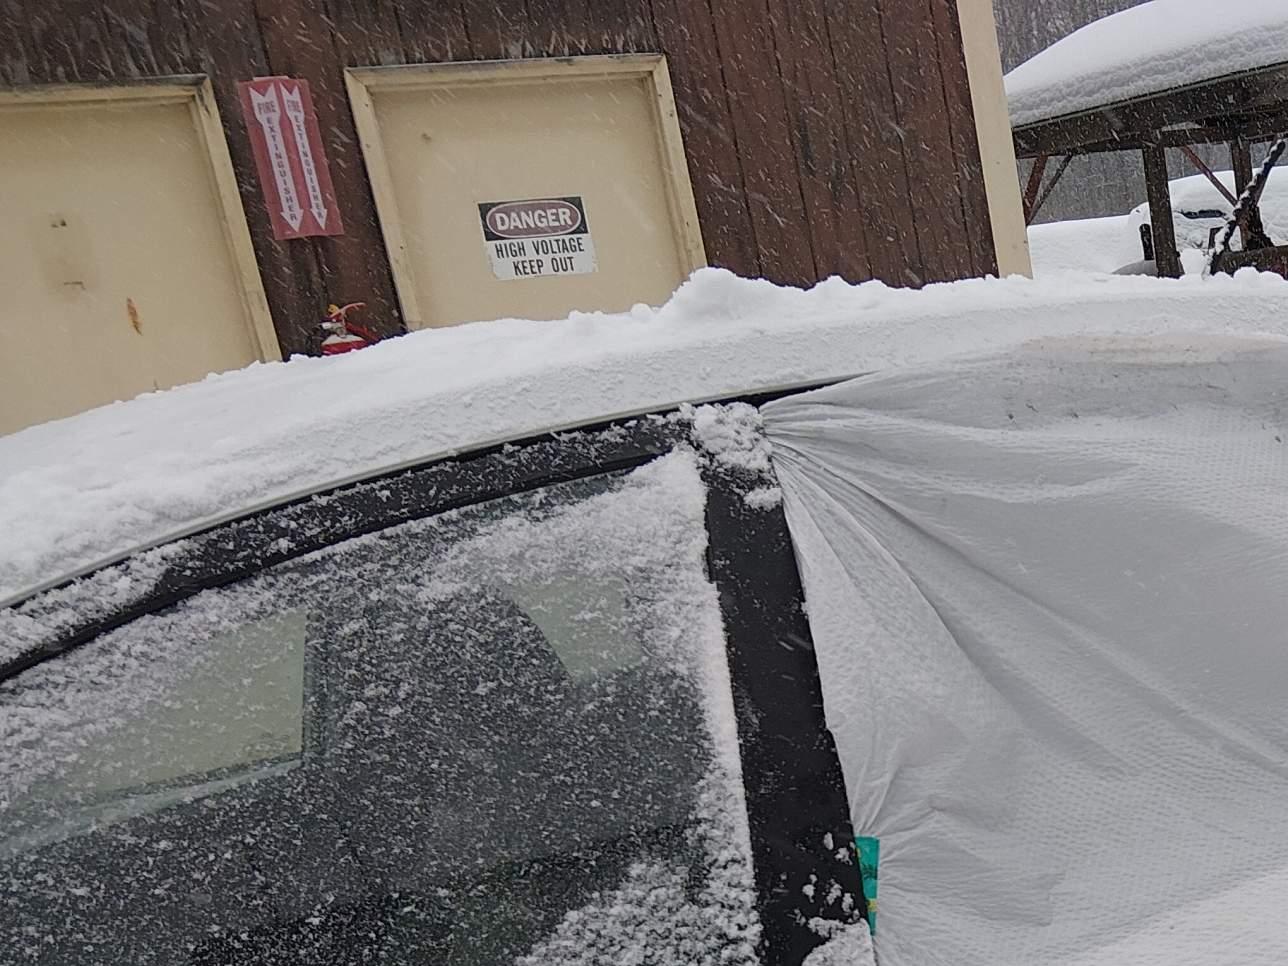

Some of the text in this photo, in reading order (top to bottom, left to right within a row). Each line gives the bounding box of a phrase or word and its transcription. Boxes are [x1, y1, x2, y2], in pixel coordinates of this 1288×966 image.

[257, 100, 277, 114] FIRE
[266, 116, 298, 222] EXTINGUISHER
[294, 115, 325, 219] EXTINGUISHER
[494, 208, 573, 231] DANGER
[494, 237, 585, 259] HIGH VOLTAGE
[513, 256, 575, 276] KEEP OUT
